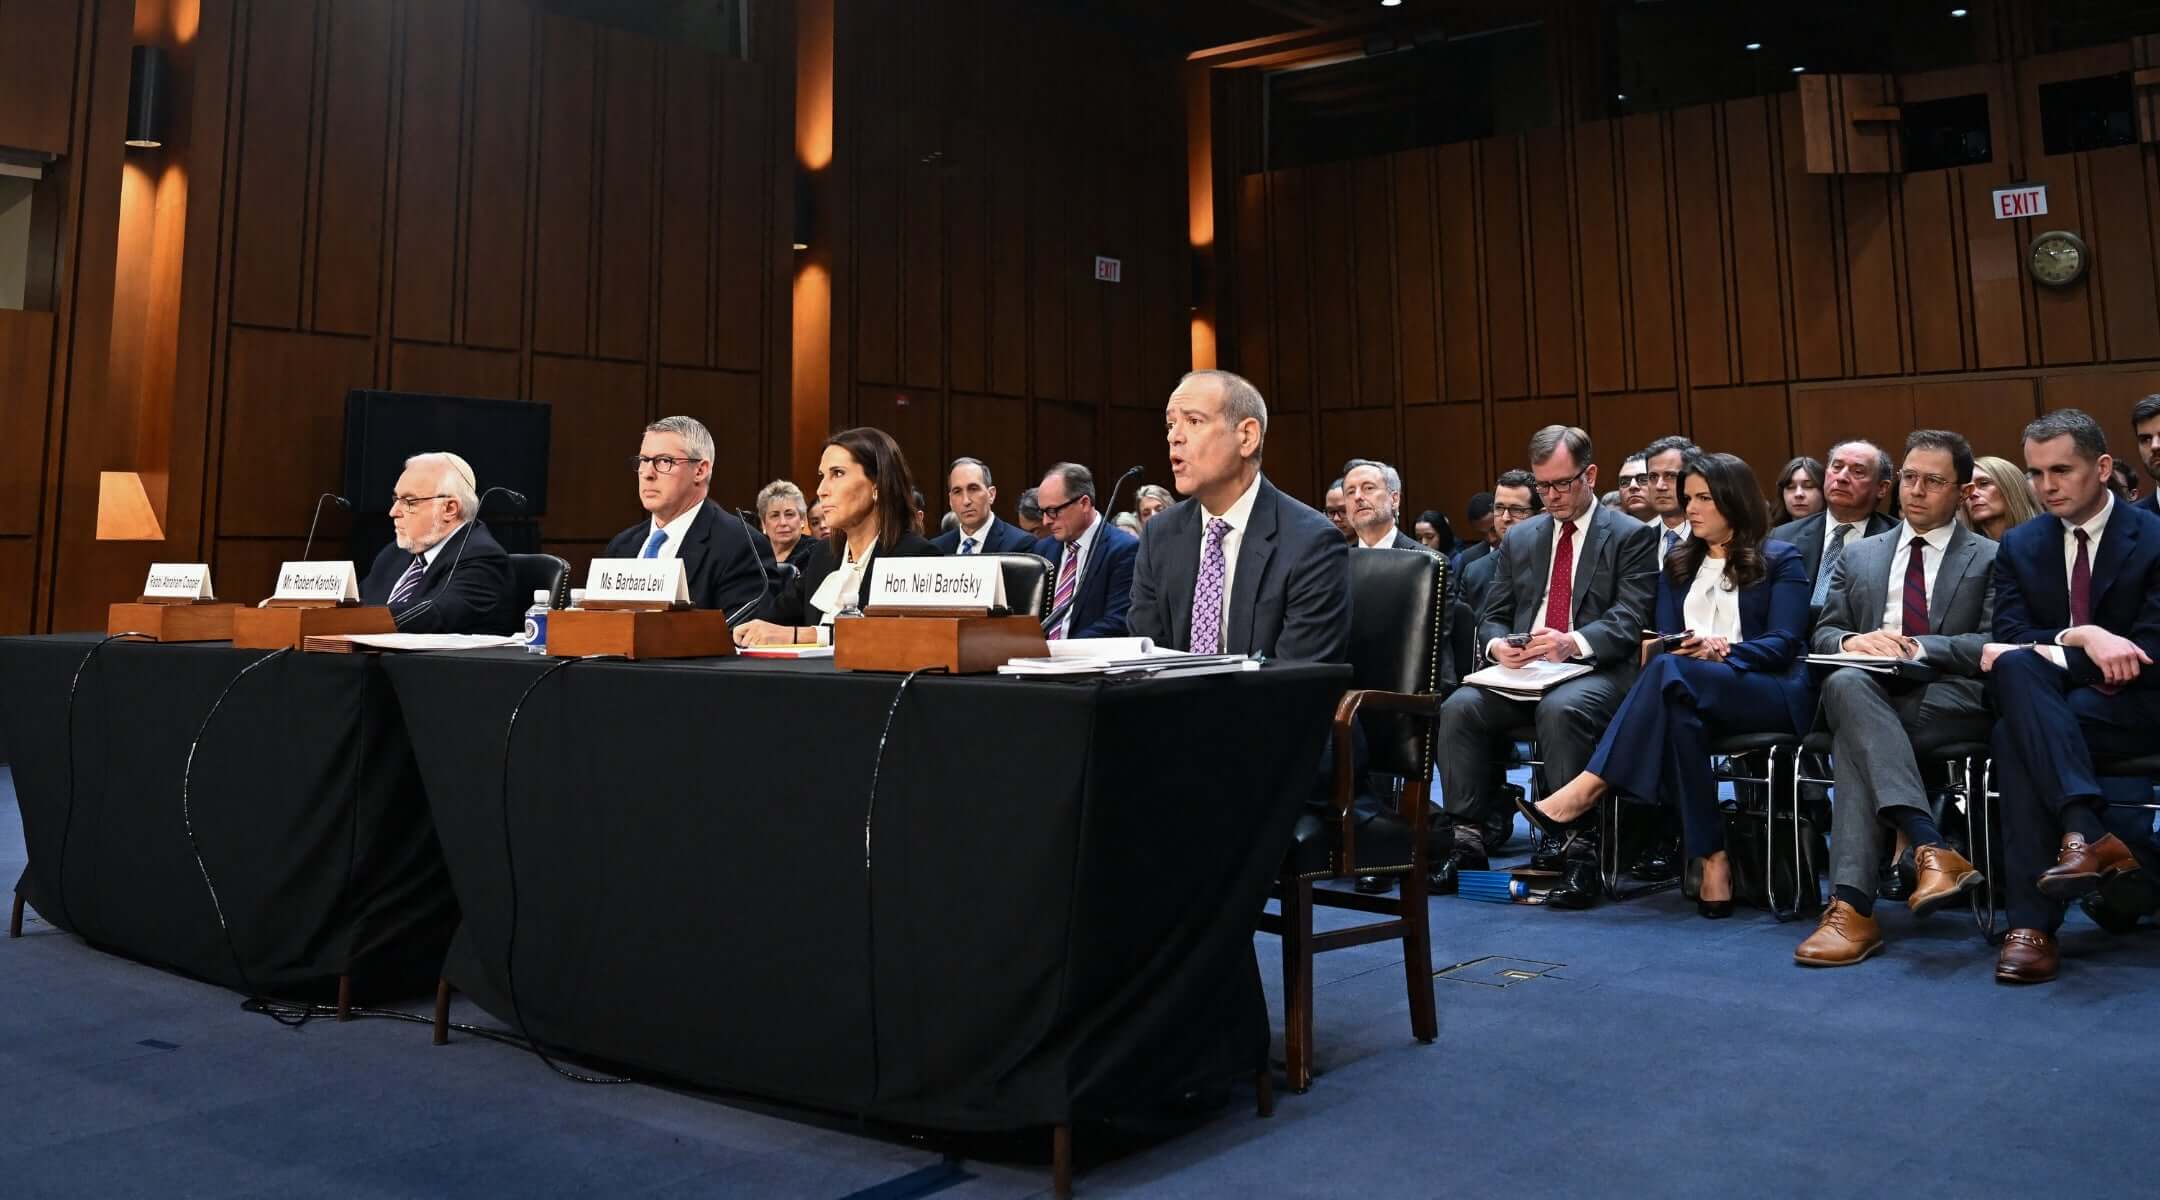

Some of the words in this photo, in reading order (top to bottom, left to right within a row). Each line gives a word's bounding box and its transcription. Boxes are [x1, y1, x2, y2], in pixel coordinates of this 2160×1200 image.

[2000, 191, 2040, 217] EXIT
[1099, 260, 1118, 281] EXIT
[283, 574, 293, 590] Mr.
[294, 574, 315, 590] Robert
[315, 574, 342, 595] Karofsky
[600, 572, 613, 590] Ms.
[616, 572, 646, 591] Barbara
[647, 573, 665, 592] Levi
[885, 573, 908, 593] Hon.
[912, 573, 932, 593] Neil
[935, 573, 982, 599] Barofsky
